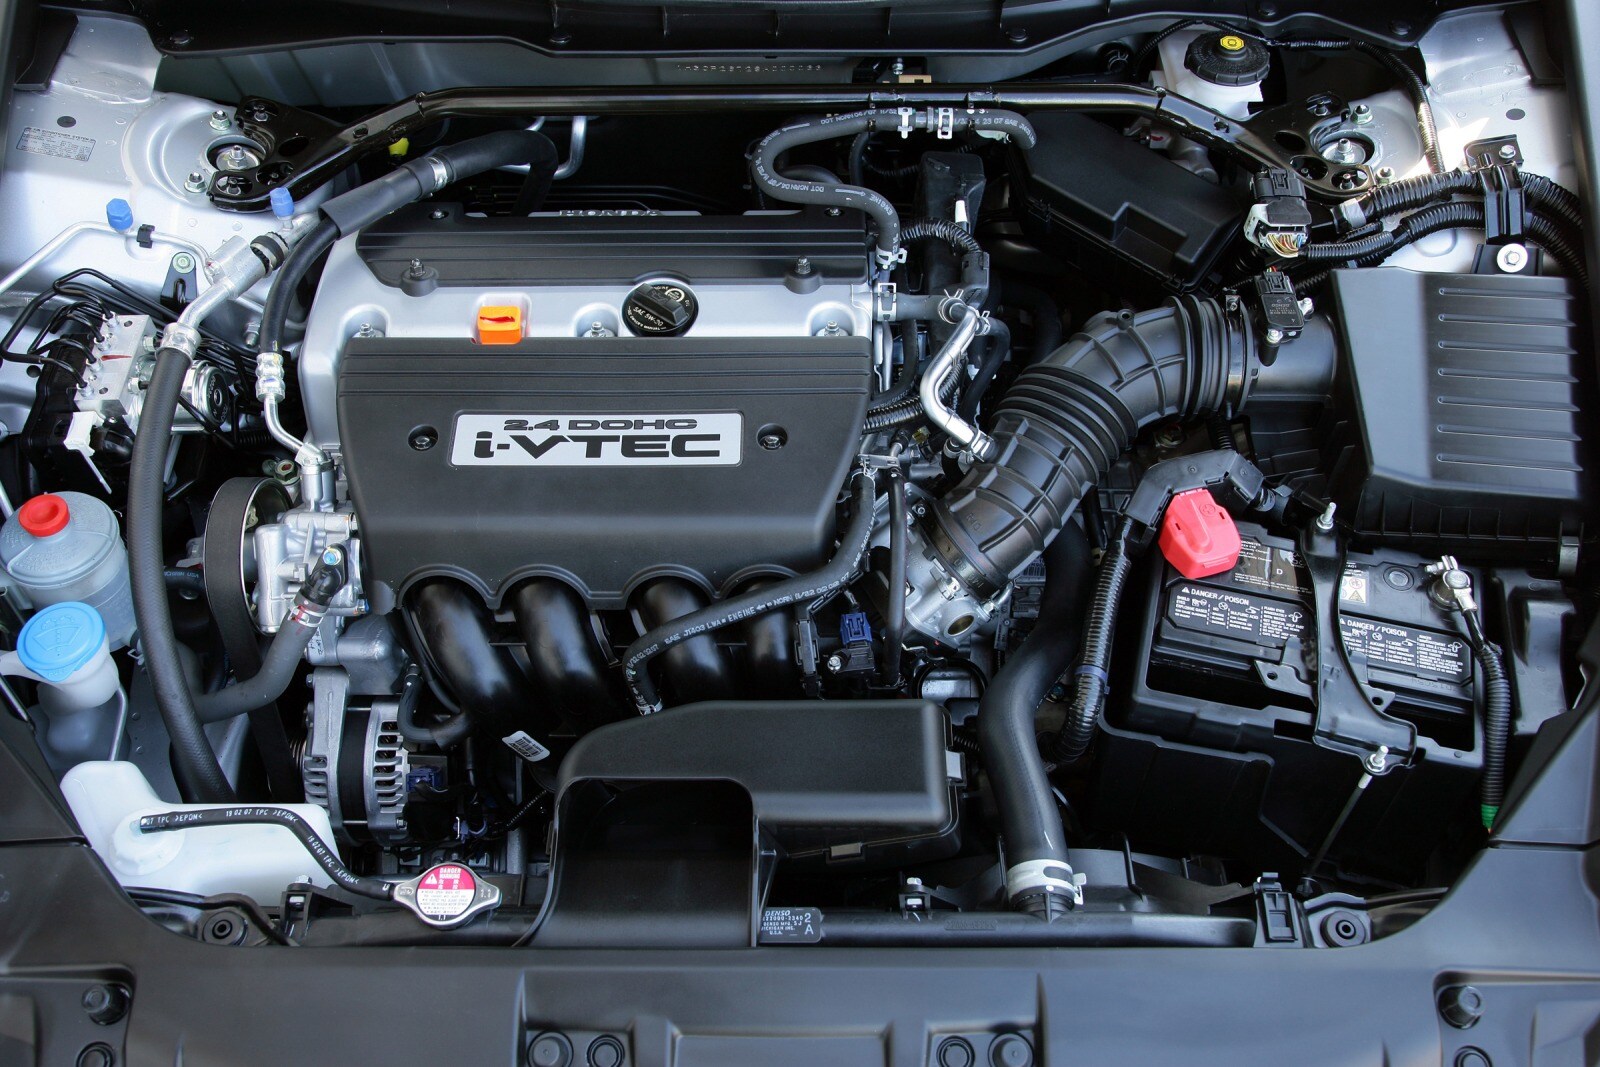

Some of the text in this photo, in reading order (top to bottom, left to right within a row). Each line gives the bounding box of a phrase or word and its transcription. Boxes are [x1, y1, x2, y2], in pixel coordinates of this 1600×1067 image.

[632, 306, 646, 316] SAE
[503, 418, 698, 431] 2.4 DOHC
[473, 431, 721, 460] i-VTEC
[1190, 588, 1218, 600] DANGER
[1224, 595, 1250, 606] POISON
[727, 606, 756, 622] ENGINE
[1347, 619, 1375, 631] DANGER
[1381, 626, 1407, 638] POISON
[764, 909, 791, 917] DENSO
[804, 912, 812, 923] 2
[804, 923, 814, 935] A
